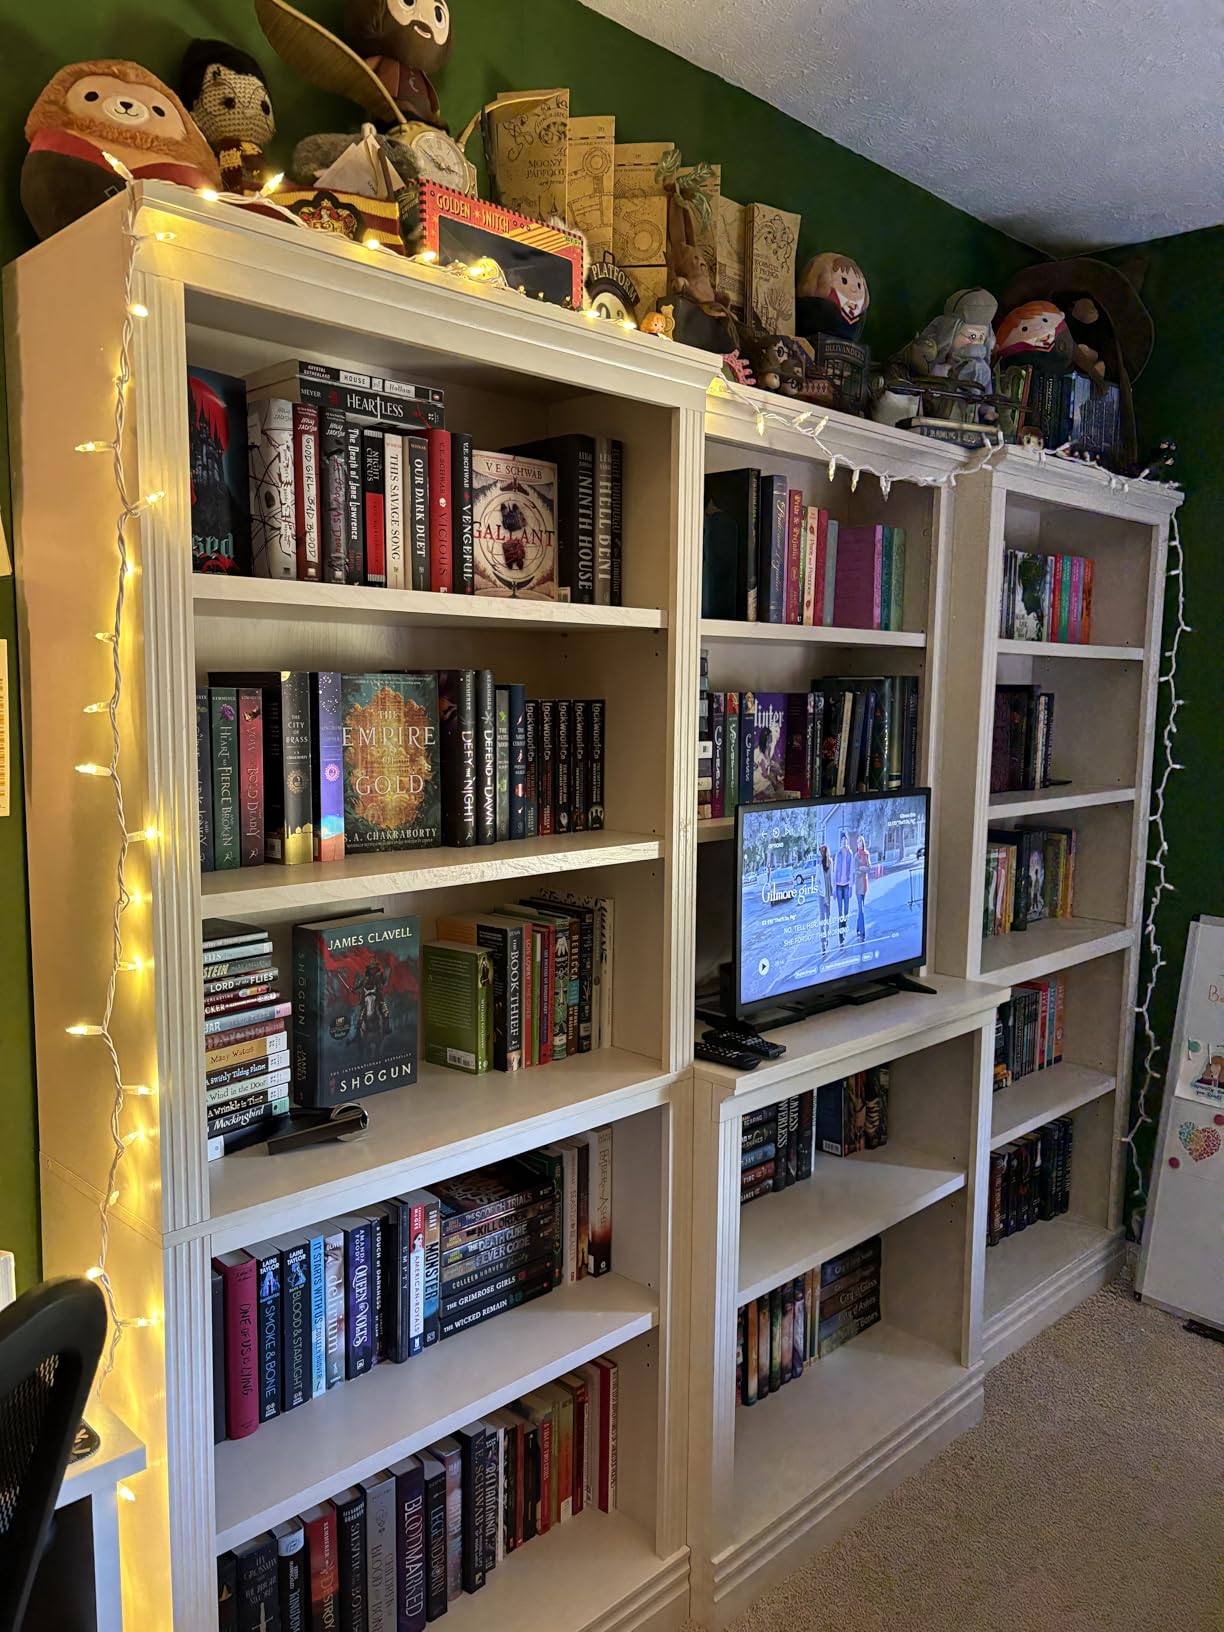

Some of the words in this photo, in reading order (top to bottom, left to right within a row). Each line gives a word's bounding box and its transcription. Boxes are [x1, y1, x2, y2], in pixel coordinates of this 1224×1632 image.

[436, 193, 471, 220] GOLDEN
[481, 208, 510, 234] SNITCH
[591, 263, 637, 302] PLATFORM
[301, 388, 321, 398] MEYER
[343, 374, 367, 385] HOUSE
[389, 383, 412, 395] Hollow
[346, 393, 404, 420] HEARTLESS
[348, 428, 359, 443] The
[305, 437, 314, 463] GOOD
[348, 445, 359, 468] Death
[350, 470, 359, 479] of
[366, 447, 374, 482] CIRCUS
[372, 450, 380, 480] NIGHT
[389, 454, 399, 482] THIS
[414, 458, 424, 482] OUR
[505, 464, 543, 480] SCHWAB
[349, 481, 360, 499] Jane
[414, 486, 425, 521] DARK
[578, 474, 593, 531] NINTH
[793, 493, 801, 515] Pride
[306, 497, 315, 520] BAD
[390, 482, 400, 527] SAVAGE
[598, 480, 612, 530] HELL
[350, 501, 360, 540] Lawrence
[473, 521, 555, 548] GALLANT
[793, 516, 801, 525] &
[307, 522, 317, 559] BLOOD
[391, 529, 401, 561] SONG
[415, 524, 426, 558] DUET
[438, 512, 448, 576] VICIOUS
[462, 504, 473, 585] VENGEFUL
[578, 535, 593, 591] HOUSE
[287, 721, 305, 729] CITY
[378, 710, 399, 721] THE
[342, 726, 436, 749] EMPIRE
[461, 730, 474, 769] DEFY
[484, 729, 494, 776] DEFEND
[355, 774, 425, 796] GOLD
[462, 776, 476, 827] NIGHT
[484, 785, 495, 825] DAWN
[761, 881, 798, 904] Gilmore
[797, 875, 819, 906] girls
[327, 935, 364, 951] JAMES
[367, 927, 413, 945] CLAVELL
[510, 951, 520, 990] BOOK
[571, 934, 580, 980] REBECCA
[210, 981, 235, 993] LORD
[250, 972, 274, 985] FLIES
[510, 993, 520, 1036] THIEF
[210, 1053, 230, 1065] Many
[232, 1047, 256, 1057] Waters
[232, 1067, 250, 1078] Tilting
[250, 1063, 266, 1073] Planet
[339, 1063, 412, 1093] SHŌGUN
[209, 1089, 229, 1102] Wind
[230, 1087, 237, 1096] in
[238, 1083, 249, 1094] the
[249, 1079, 267, 1091] Door
[207, 1109, 214, 1118] A
[213, 1100, 241, 1116] Wrinkle
[247, 1095, 264, 1106] Time
[213, 1105, 265, 1131] Mockingbird
[465, 1213, 476, 1221] THE
[475, 1201, 507, 1220] SCORCH
[507, 1193, 533, 1209] TRIALS
[313, 1241, 322, 1252] IT
[467, 1244, 479, 1252] THE
[478, 1235, 505, 1251] DEATH
[505, 1224, 528, 1240] CURE
[262, 1257, 277, 1269] LAINI
[286, 1253, 307, 1266] TAYLOR
[289, 1249, 304, 1259] LAINI
[259, 1262, 280, 1275] TAYLOR
[313, 1252, 323, 1286] STARTS
[425, 1241, 439, 1300] MONSTER
[353, 1265, 369, 1304] QUEEN
[446, 1303, 459, 1311] THE
[458, 1285, 495, 1306] GRIMROSE
[496, 1276, 516, 1290] GIRLS
[240, 1303, 251, 1325] ONE
[292, 1290, 302, 1327] BLOOD
[314, 1287, 323, 1313] WITH
[265, 1305, 276, 1349] SMOKE
[315, 1313, 323, 1325] US
[328, 1275, 344, 1354] delirium
[353, 1302, 369, 1348] VOLTS
[444, 1325, 454, 1333] THE
[454, 1312, 482, 1329] WICKED
[482, 1299, 508, 1317] REMAIN
[242, 1327, 250, 1339] OF
[292, 1328, 303, 1337] &
[315, 1326, 323, 1352] COLLEEN
[240, 1339, 252, 1356] US
[265, 1350, 276, 1362] &
[292, 1337, 303, 1389] STARLIGHT
[240, 1367, 252, 1397] LYING
[265, 1362, 276, 1399] BONE
[485, 1463, 497, 1537] BELLADONNA
[350, 1522, 360, 1570] SILVER
[404, 1495, 424, 1617] BLOODMARKED
[430, 1504, 445, 1597] LEGENDBORN
